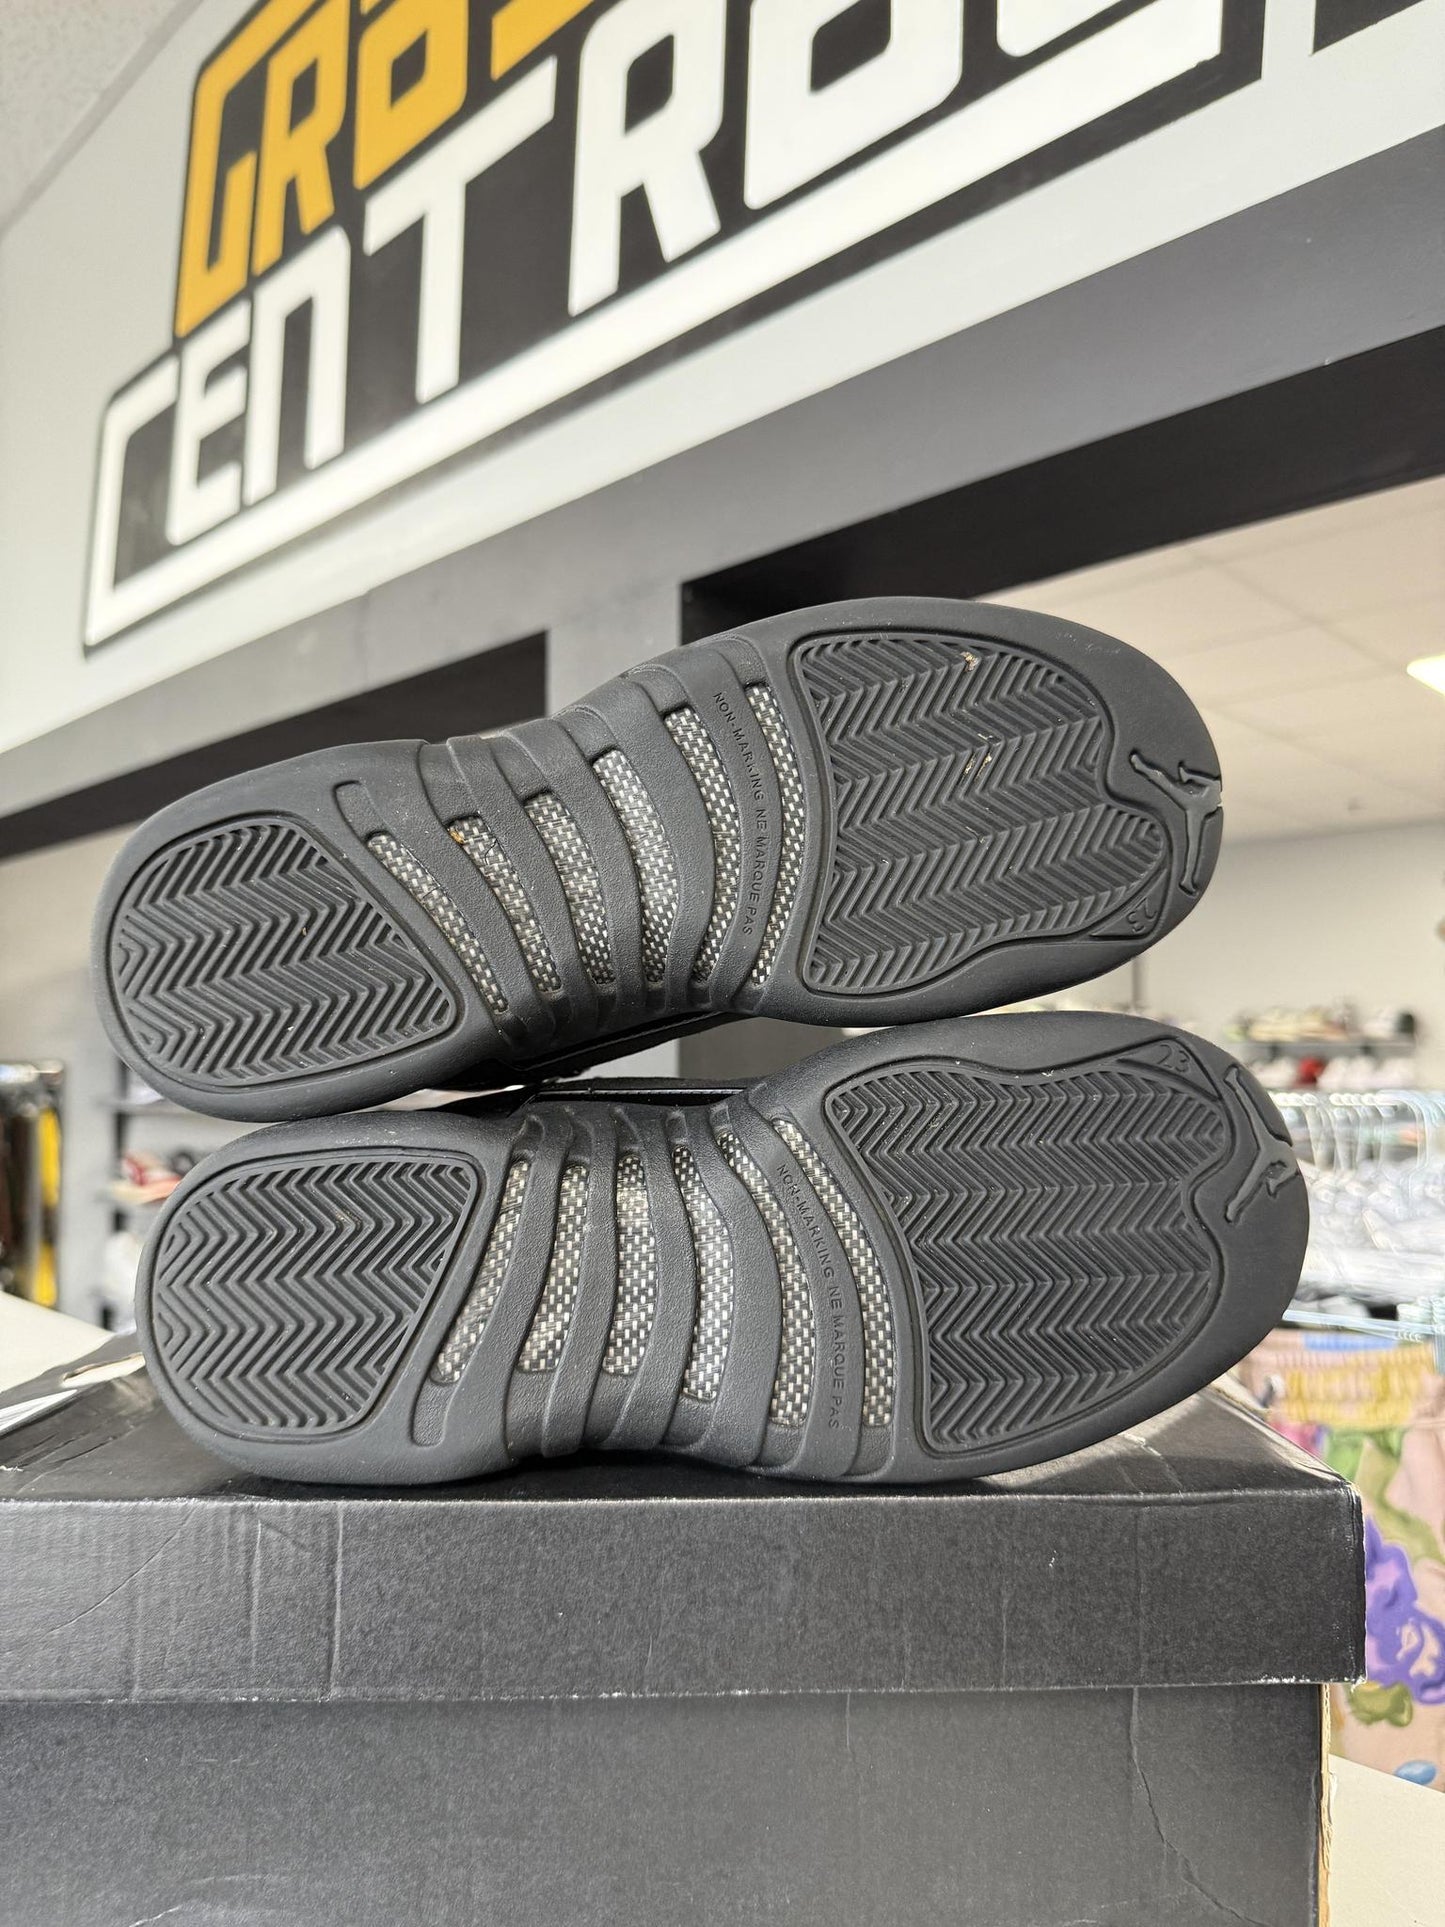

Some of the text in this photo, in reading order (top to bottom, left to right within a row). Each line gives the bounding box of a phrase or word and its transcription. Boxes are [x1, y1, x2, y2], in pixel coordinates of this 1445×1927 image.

[713, 692, 768, 936] NON-MARKING NE MARQUE PAS
[1157, 1043, 1191, 1073] 23
[776, 1163, 845, 1429] NON-MARKING NE MARQUE PAS
